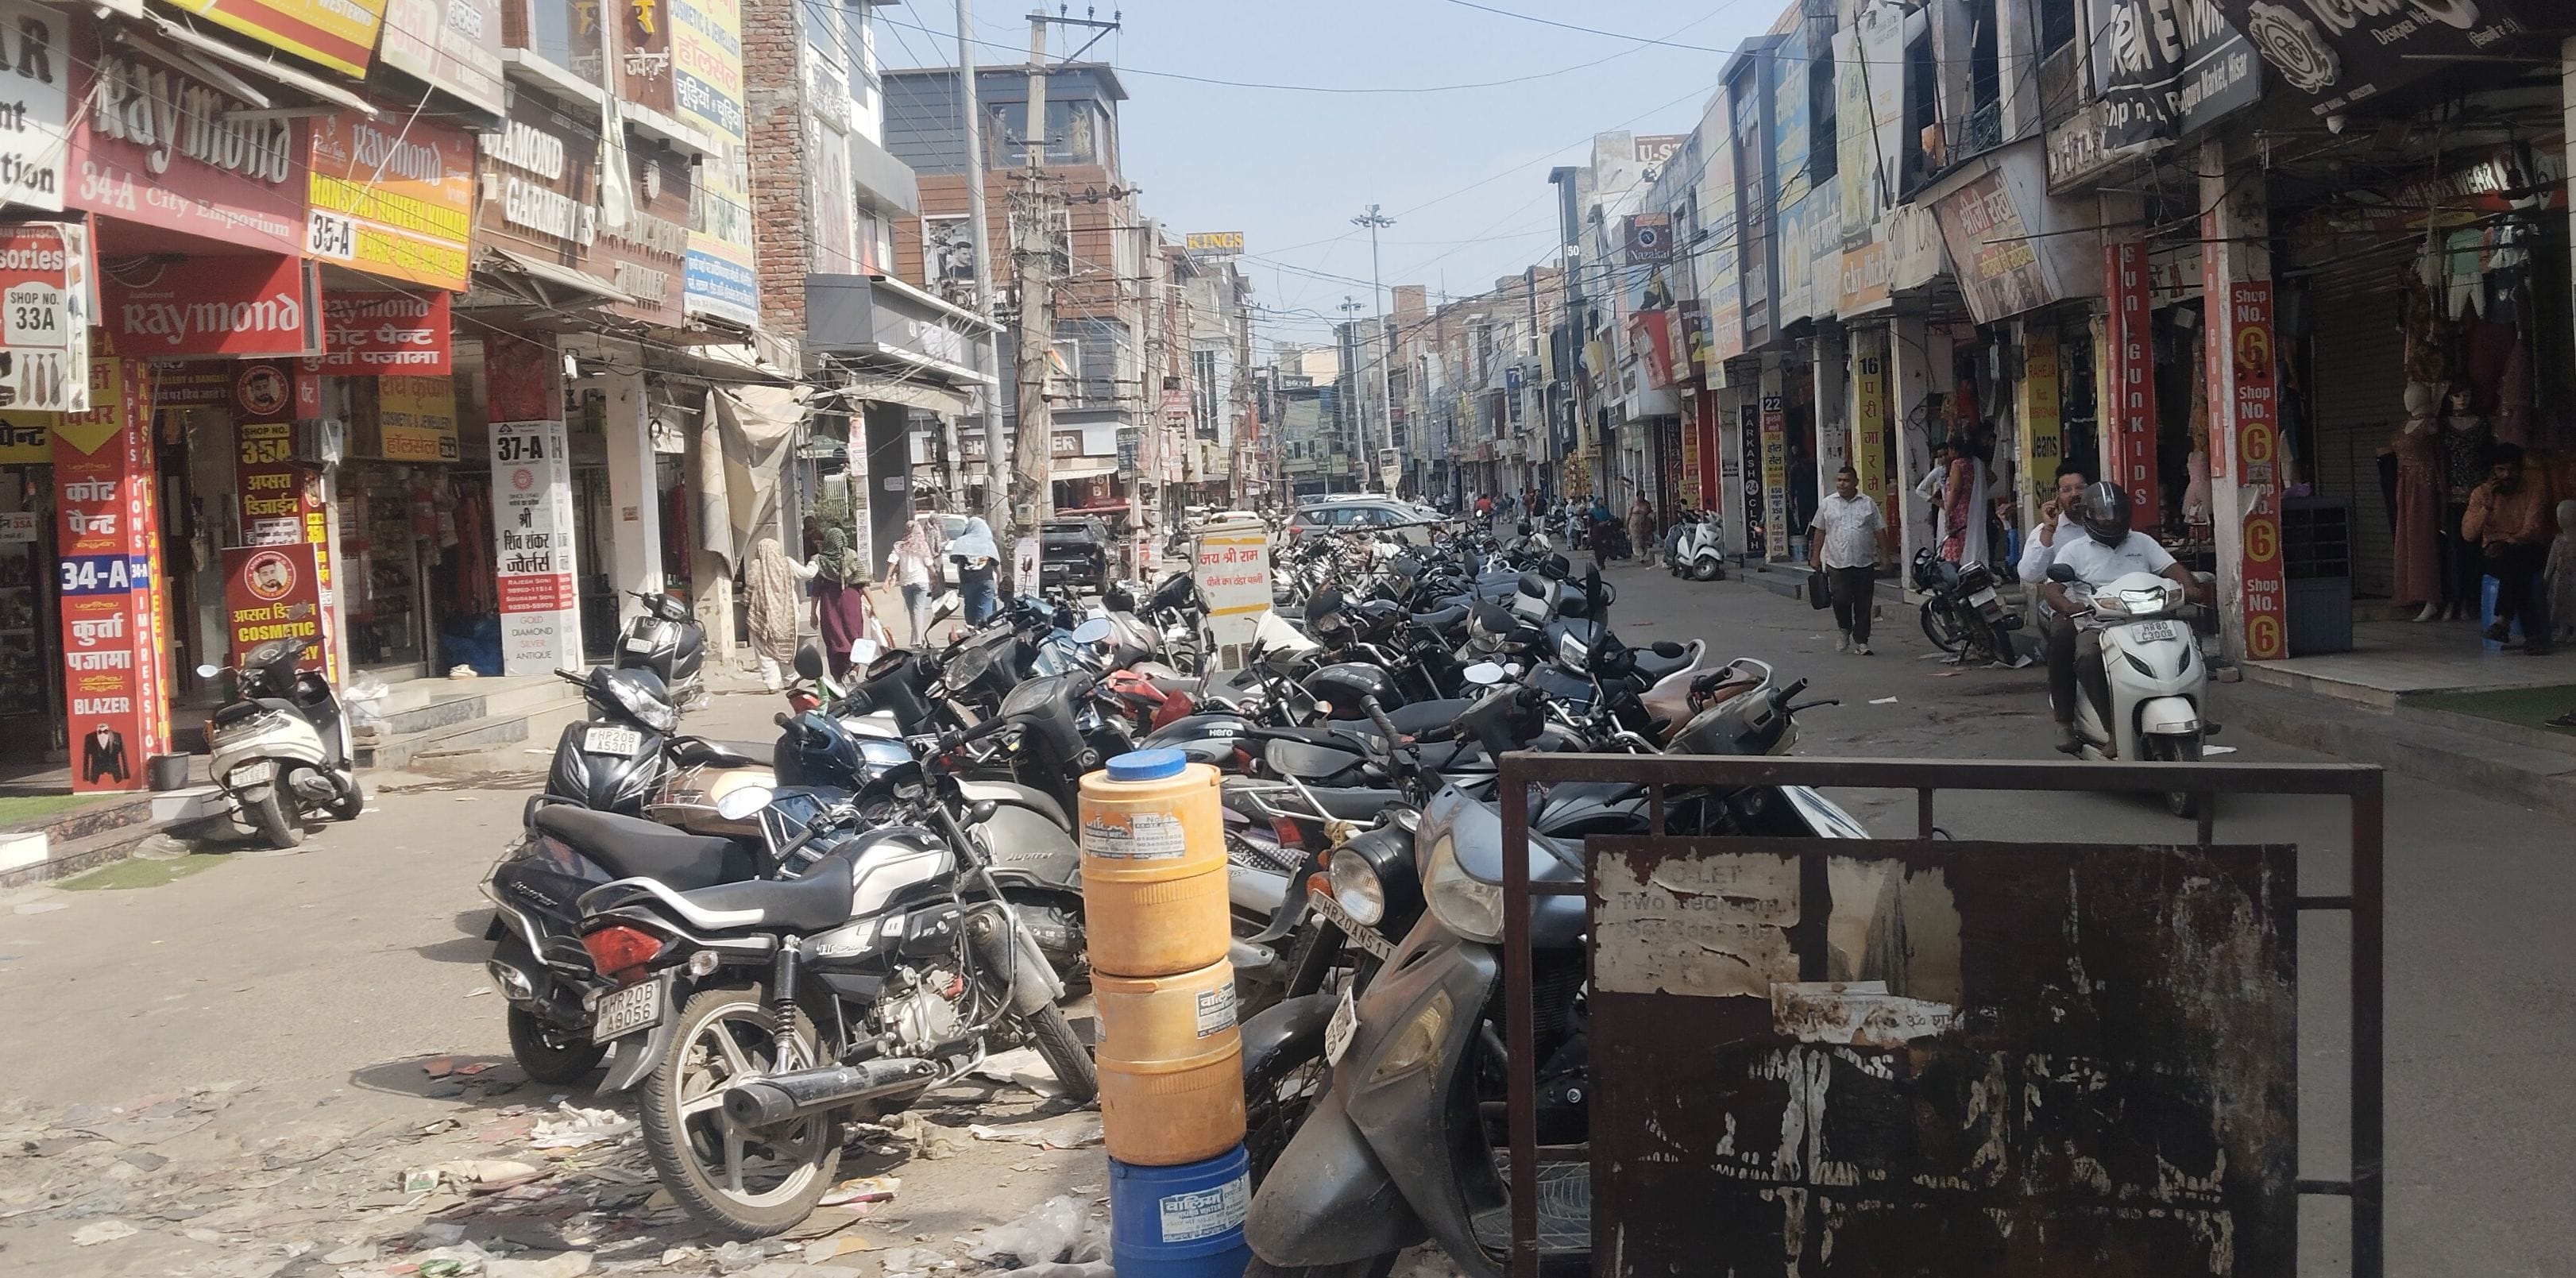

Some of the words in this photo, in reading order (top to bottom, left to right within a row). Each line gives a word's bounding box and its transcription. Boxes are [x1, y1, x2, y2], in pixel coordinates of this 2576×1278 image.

[352, 122, 442, 187] Raymond
[81, 161, 137, 212] 34-A
[146, 186, 189, 218] City
[195, 199, 290, 237] Emporium
[427, 204, 469, 244] KUMAR
[312, 214, 350, 256] 35-A
[1187, 234, 1244, 249] KINGS
[10, 292, 38, 304] SHOP
[42, 293, 60, 305] NO.
[2234, 289, 2267, 303] Shop
[16, 307, 56, 330] 33A
[122, 292, 299, 345] Raymond
[2237, 305, 2265, 322] No.
[2237, 325, 2269, 370] 6
[1861, 357, 1879, 375] 16
[2238, 385, 2271, 401] Shop
[1765, 399, 1782, 411] 22
[2241, 402, 2270, 419] No.
[242, 438, 292, 465] 35A
[497, 435, 543, 461] 37-A
[2031, 429, 2058, 458] Jeans
[2241, 422, 2273, 465] 6
[64, 476, 117, 502] कोट
[66, 508, 117, 535] पैन्ट
[519, 507, 532, 528] श्री
[504, 529, 523, 551] शिव
[525, 531, 550, 550] शंकर
[2246, 519, 2277, 563] 6
[1200, 552, 1220, 566] जय
[1223, 546, 1237, 563] श्री
[1239, 549, 1258, 562] राम
[61, 560, 129, 591] 34-A
[1222, 577, 1232, 586] का
[2246, 578, 2279, 594] Shop
[2248, 594, 2278, 612] No.
[71, 612, 124, 647] कुर्ता
[512, 627, 554, 637] DIAMOND
[2248, 615, 2280, 658] 6
[520, 639, 546, 648] SILVER
[67, 650, 132, 671] पजामा
[516, 651, 552, 660] ANTIQUE
[74, 697, 130, 716] BLAZER
[596, 740, 634, 753] A5301
[597, 729, 636, 743] HR20B
[608, 983, 655, 1011] HR20B
[606, 1004, 651, 1032] A9056
